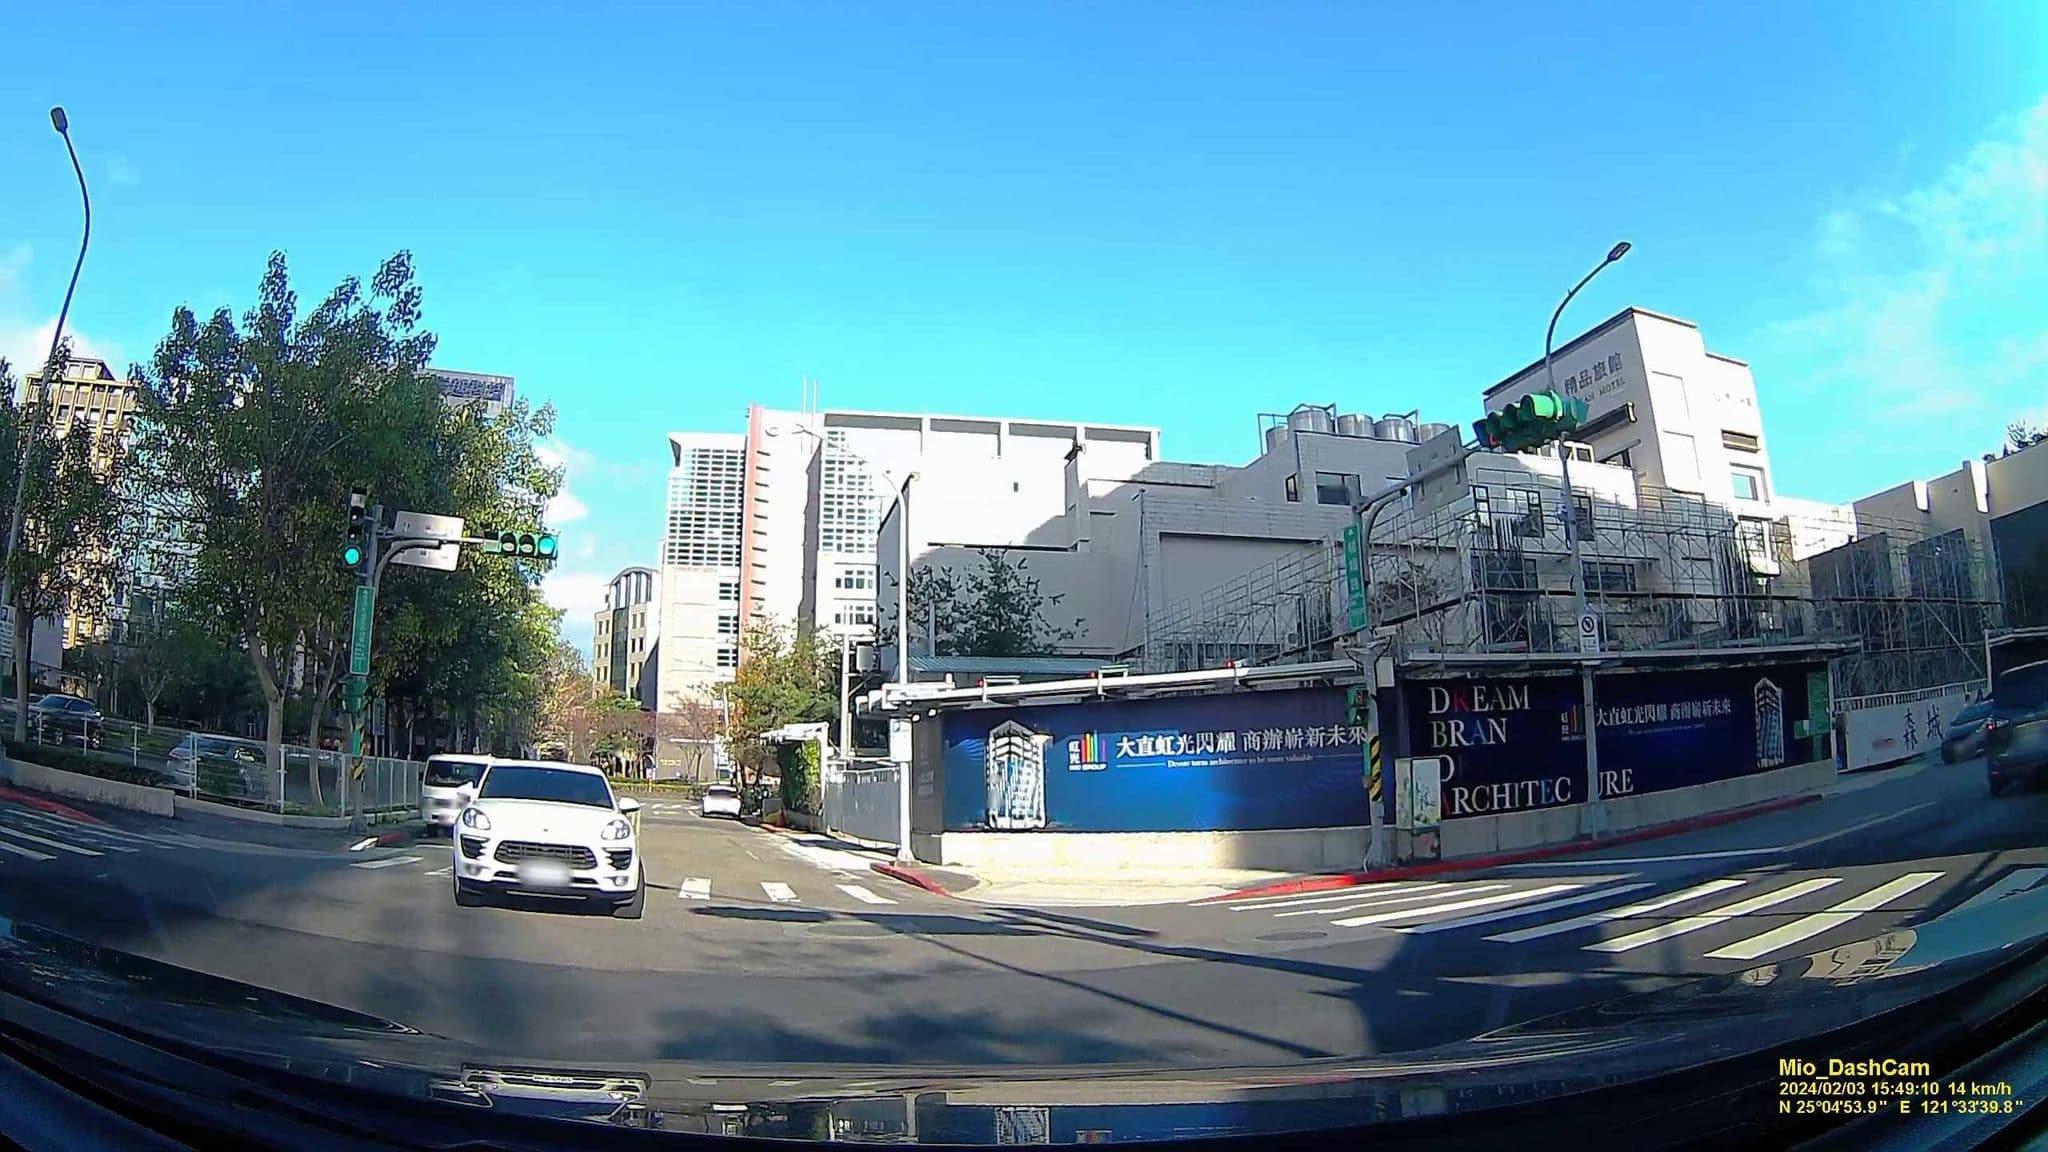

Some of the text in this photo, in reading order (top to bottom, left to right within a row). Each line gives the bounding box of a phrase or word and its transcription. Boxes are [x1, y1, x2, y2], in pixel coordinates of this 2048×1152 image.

[1429, 685, 1531, 714] DREAM
[1116, 731, 1236, 758] 大直虹光閃耀
[1432, 717, 1507, 748] BRAN
